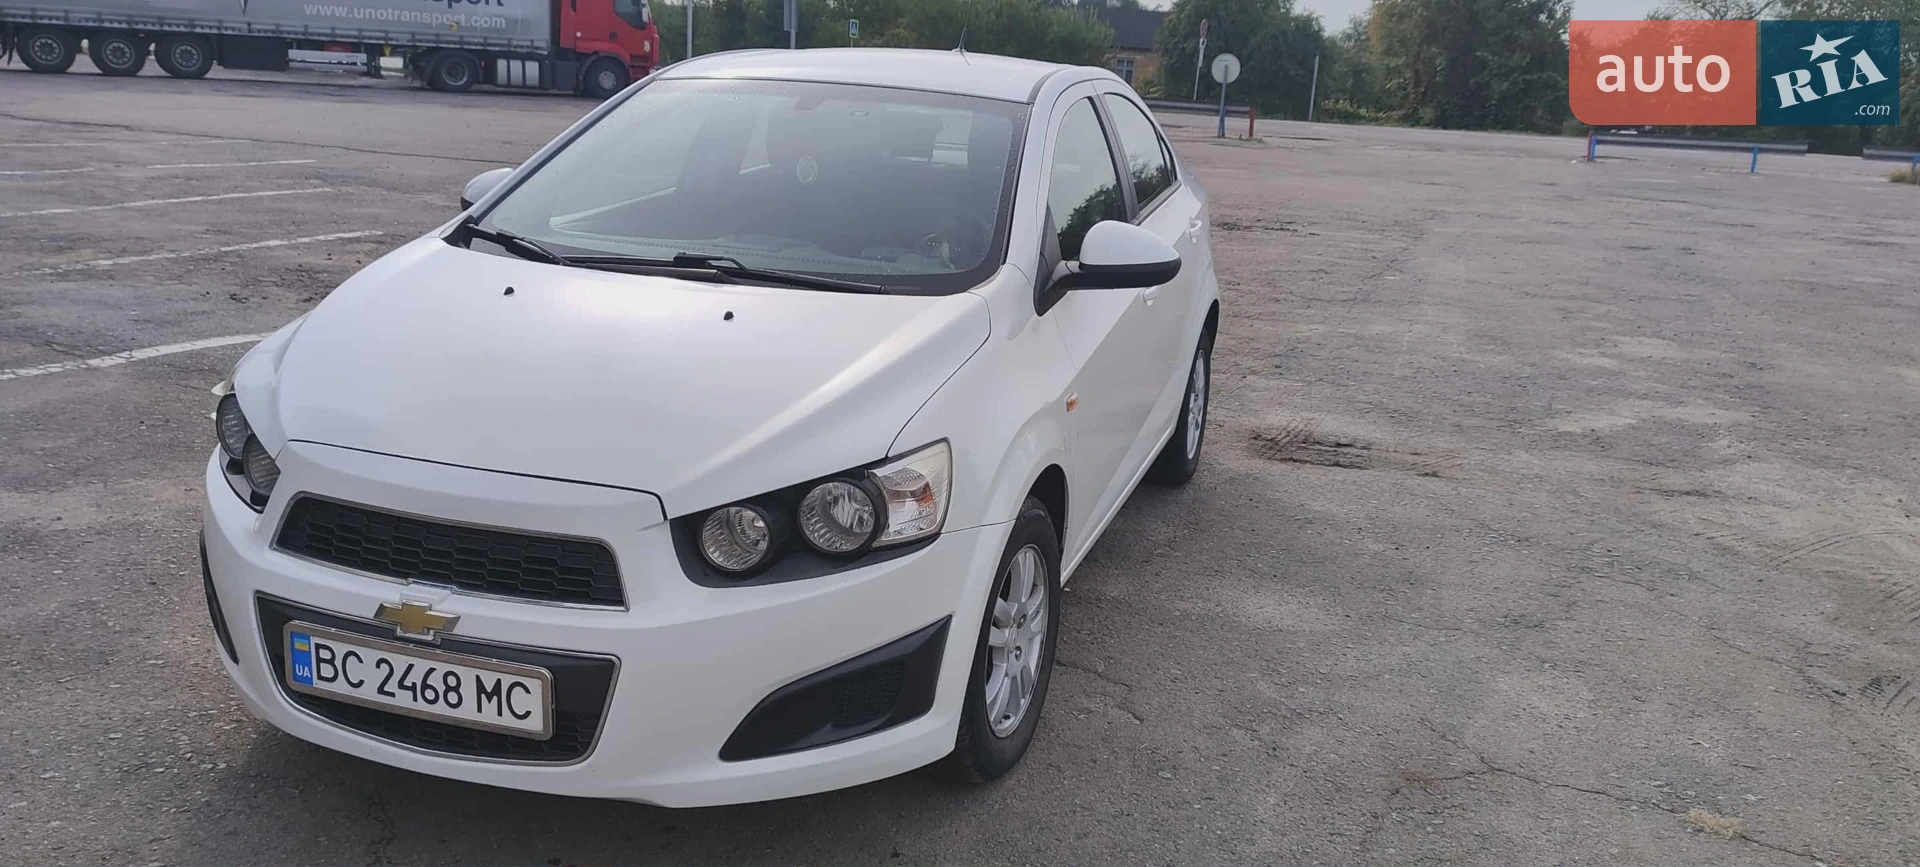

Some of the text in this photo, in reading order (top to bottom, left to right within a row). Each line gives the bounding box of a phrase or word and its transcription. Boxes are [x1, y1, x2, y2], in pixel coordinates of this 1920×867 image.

[303, 4, 506, 28] www.unotransport.com
[295, 664, 311, 678] UA
[314, 642, 532, 720] BC 2468 MC
